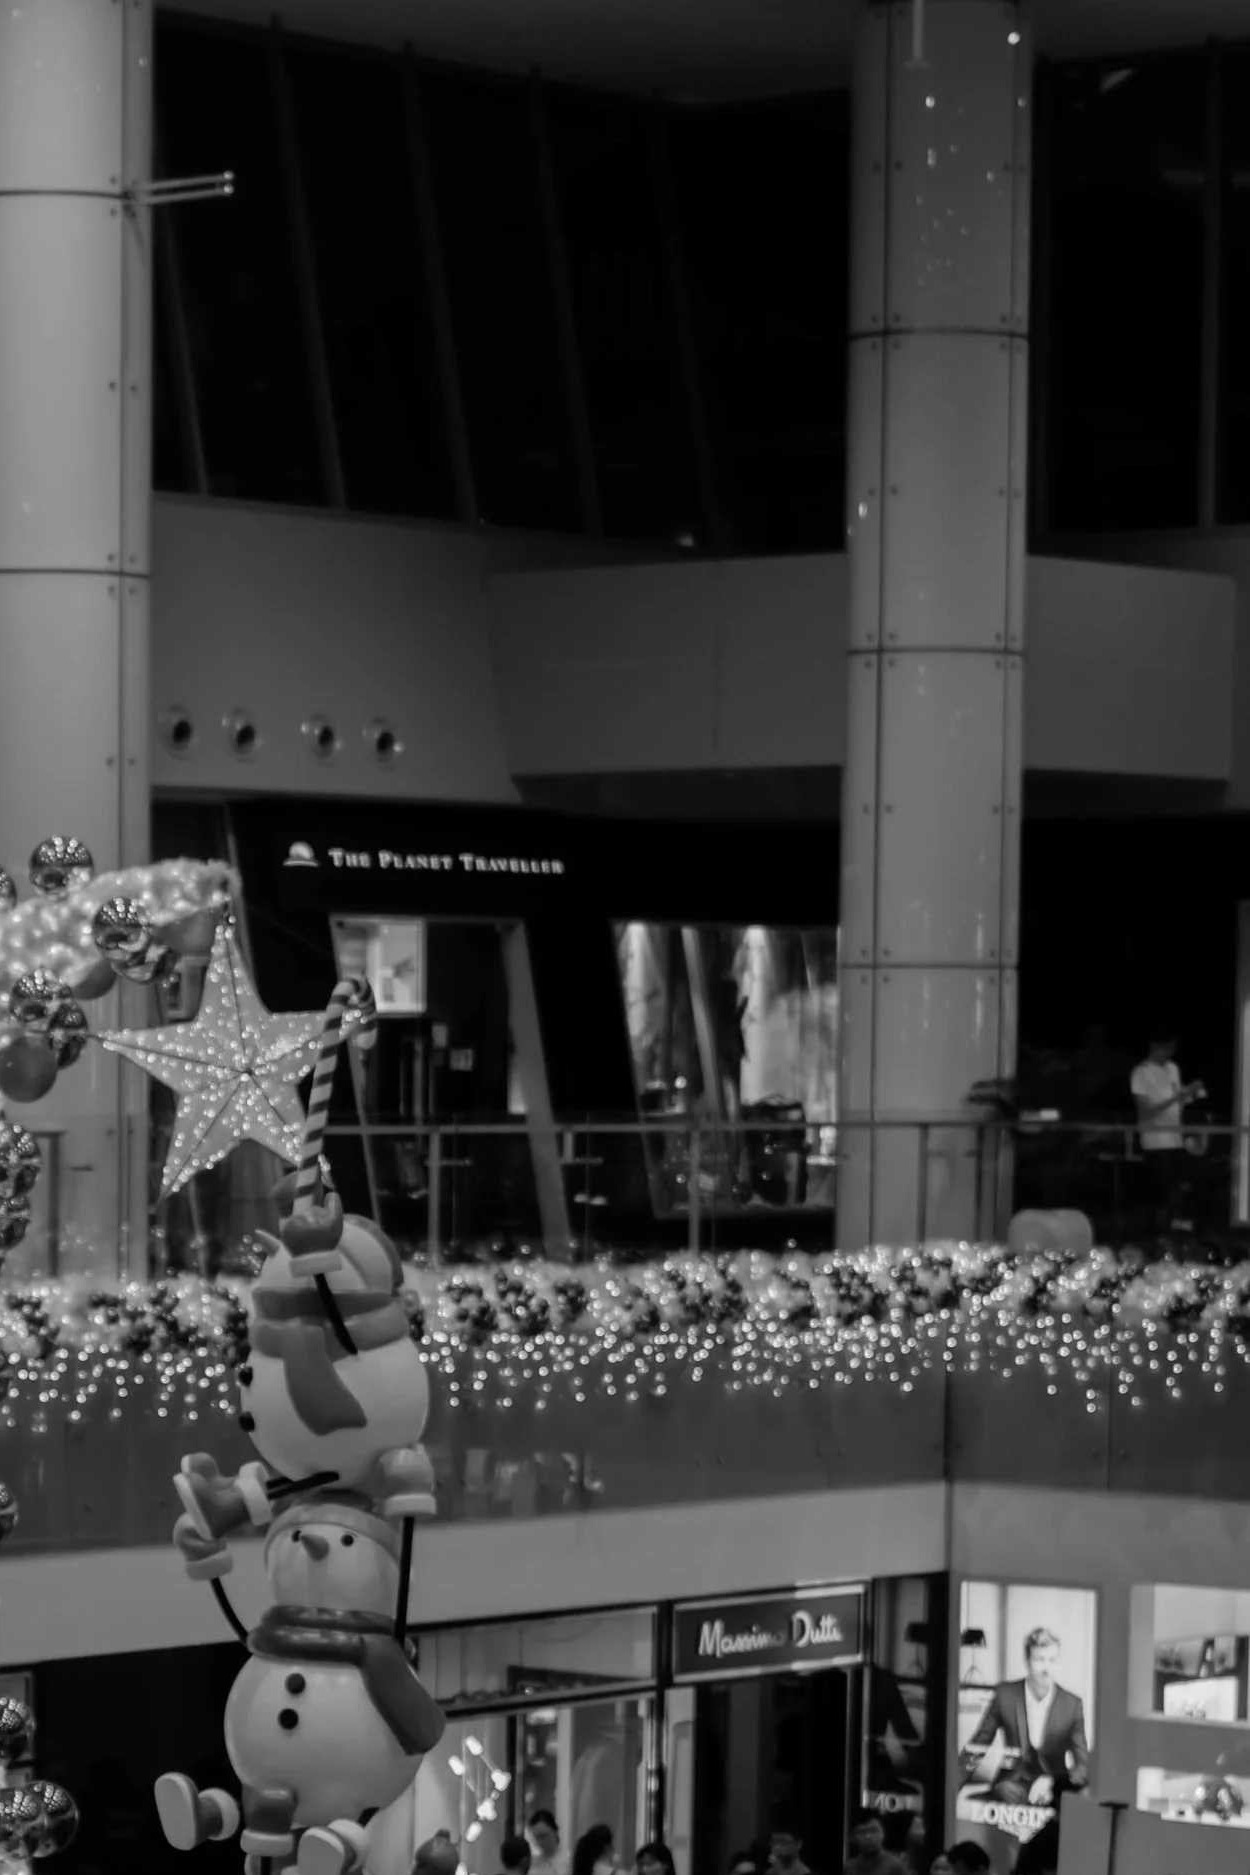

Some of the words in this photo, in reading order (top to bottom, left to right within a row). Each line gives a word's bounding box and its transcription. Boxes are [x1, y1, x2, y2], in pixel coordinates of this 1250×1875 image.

[327, 847, 372, 869] THE
[378, 849, 453, 871] PLANET
[459, 852, 566, 875] TRAVELLER
[698, 1619, 786, 1658] Massimo
[791, 1610, 842, 1648] Dutti
